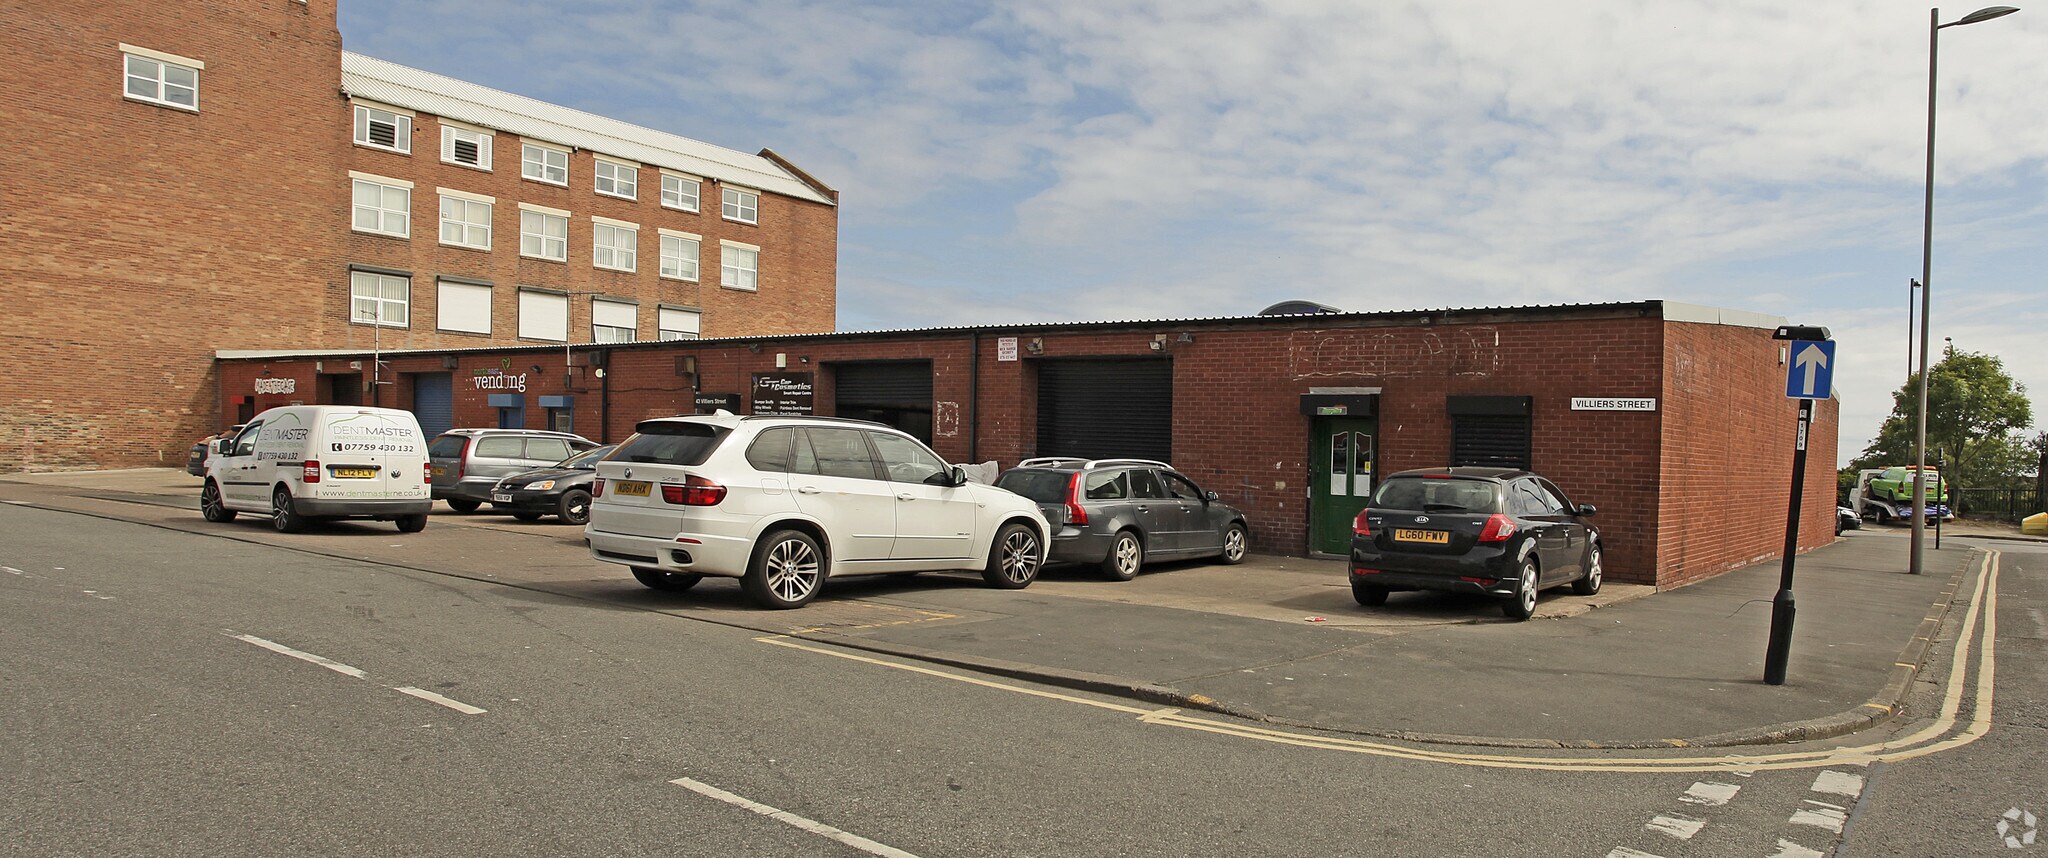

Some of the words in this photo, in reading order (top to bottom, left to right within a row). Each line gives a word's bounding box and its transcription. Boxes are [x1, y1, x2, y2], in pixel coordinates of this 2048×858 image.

[774, 382, 812, 391] Cosmetics
[1575, 400, 1615, 408] VILLIERS
[1617, 400, 1651, 408] STREET
[333, 426, 413, 437] DENTMASTER
[344, 443, 376, 451] 07759
[378, 444, 396, 452] 430
[633, 483, 647, 494] AHX
[1399, 530, 1423, 540] LG60
[1425, 531, 1445, 541] FWV
